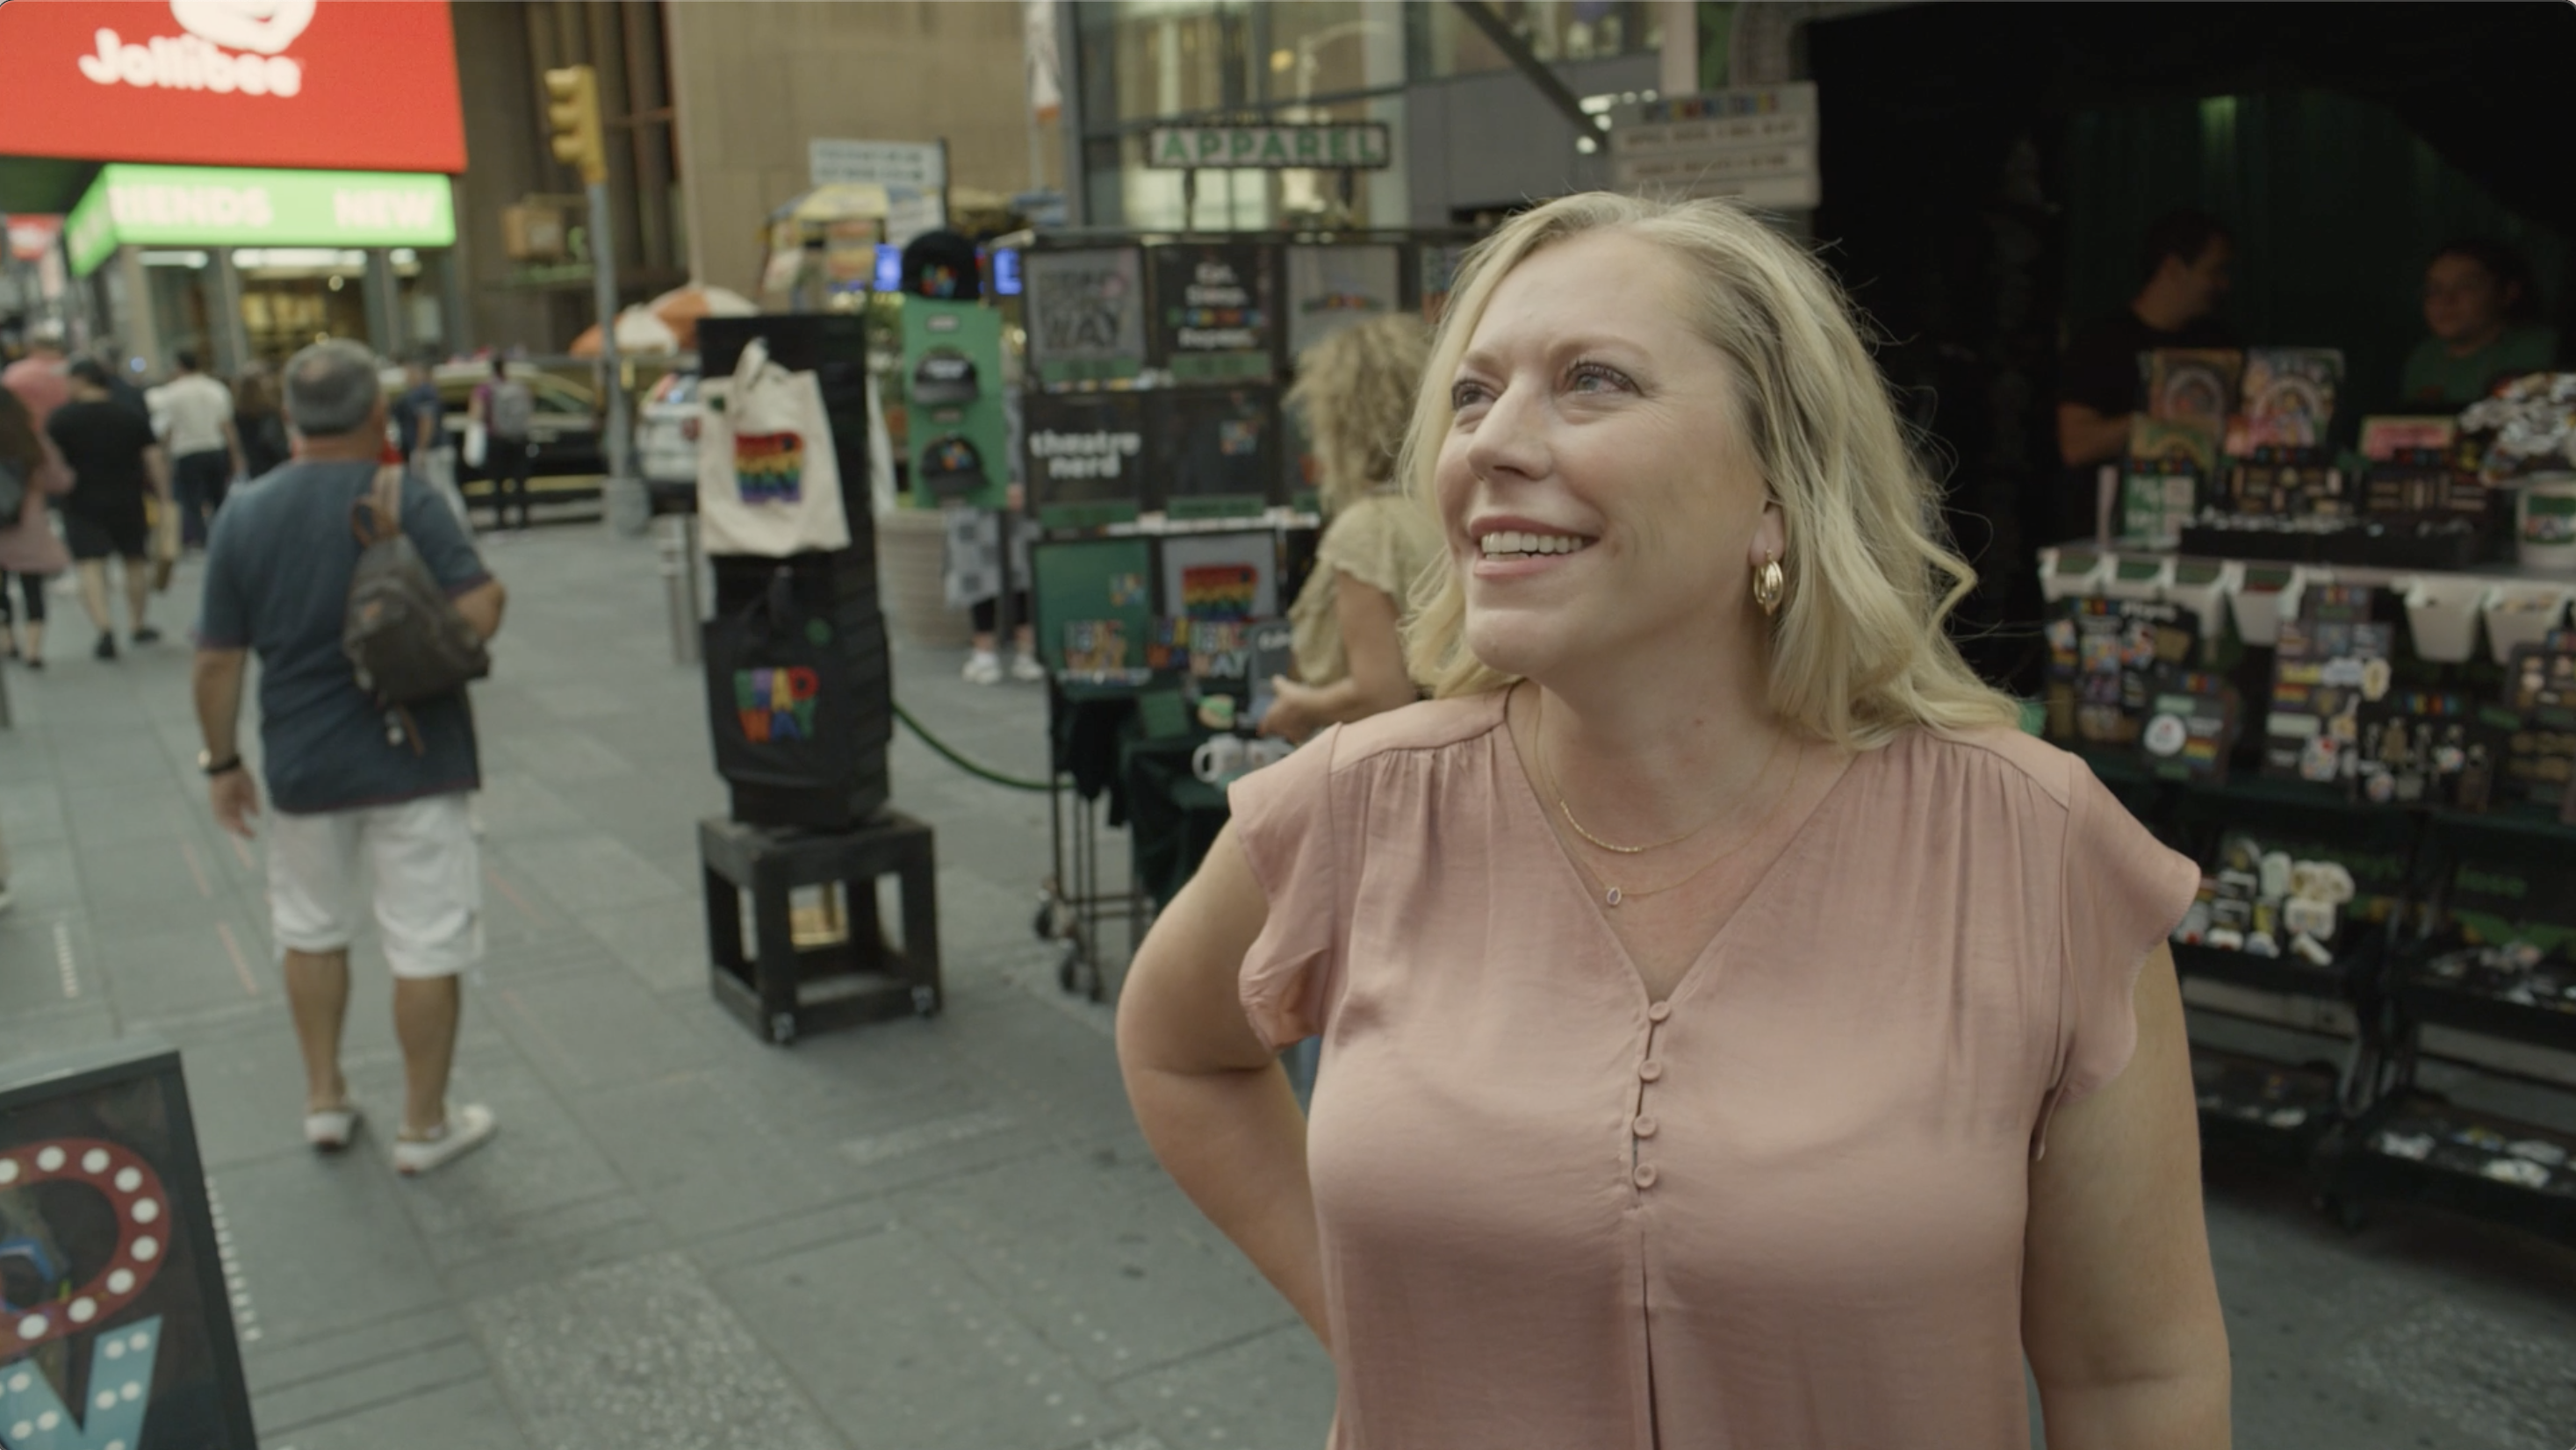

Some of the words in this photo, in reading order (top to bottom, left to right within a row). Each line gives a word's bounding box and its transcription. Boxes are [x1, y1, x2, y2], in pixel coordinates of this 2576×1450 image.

[78, 27, 302, 98] Jollibee
[1162, 129, 1381, 162] APPAREL
[334, 188, 439, 230] NEW
[1028, 428, 1141, 457] theatre
[1048, 449, 1121, 478] nerd
